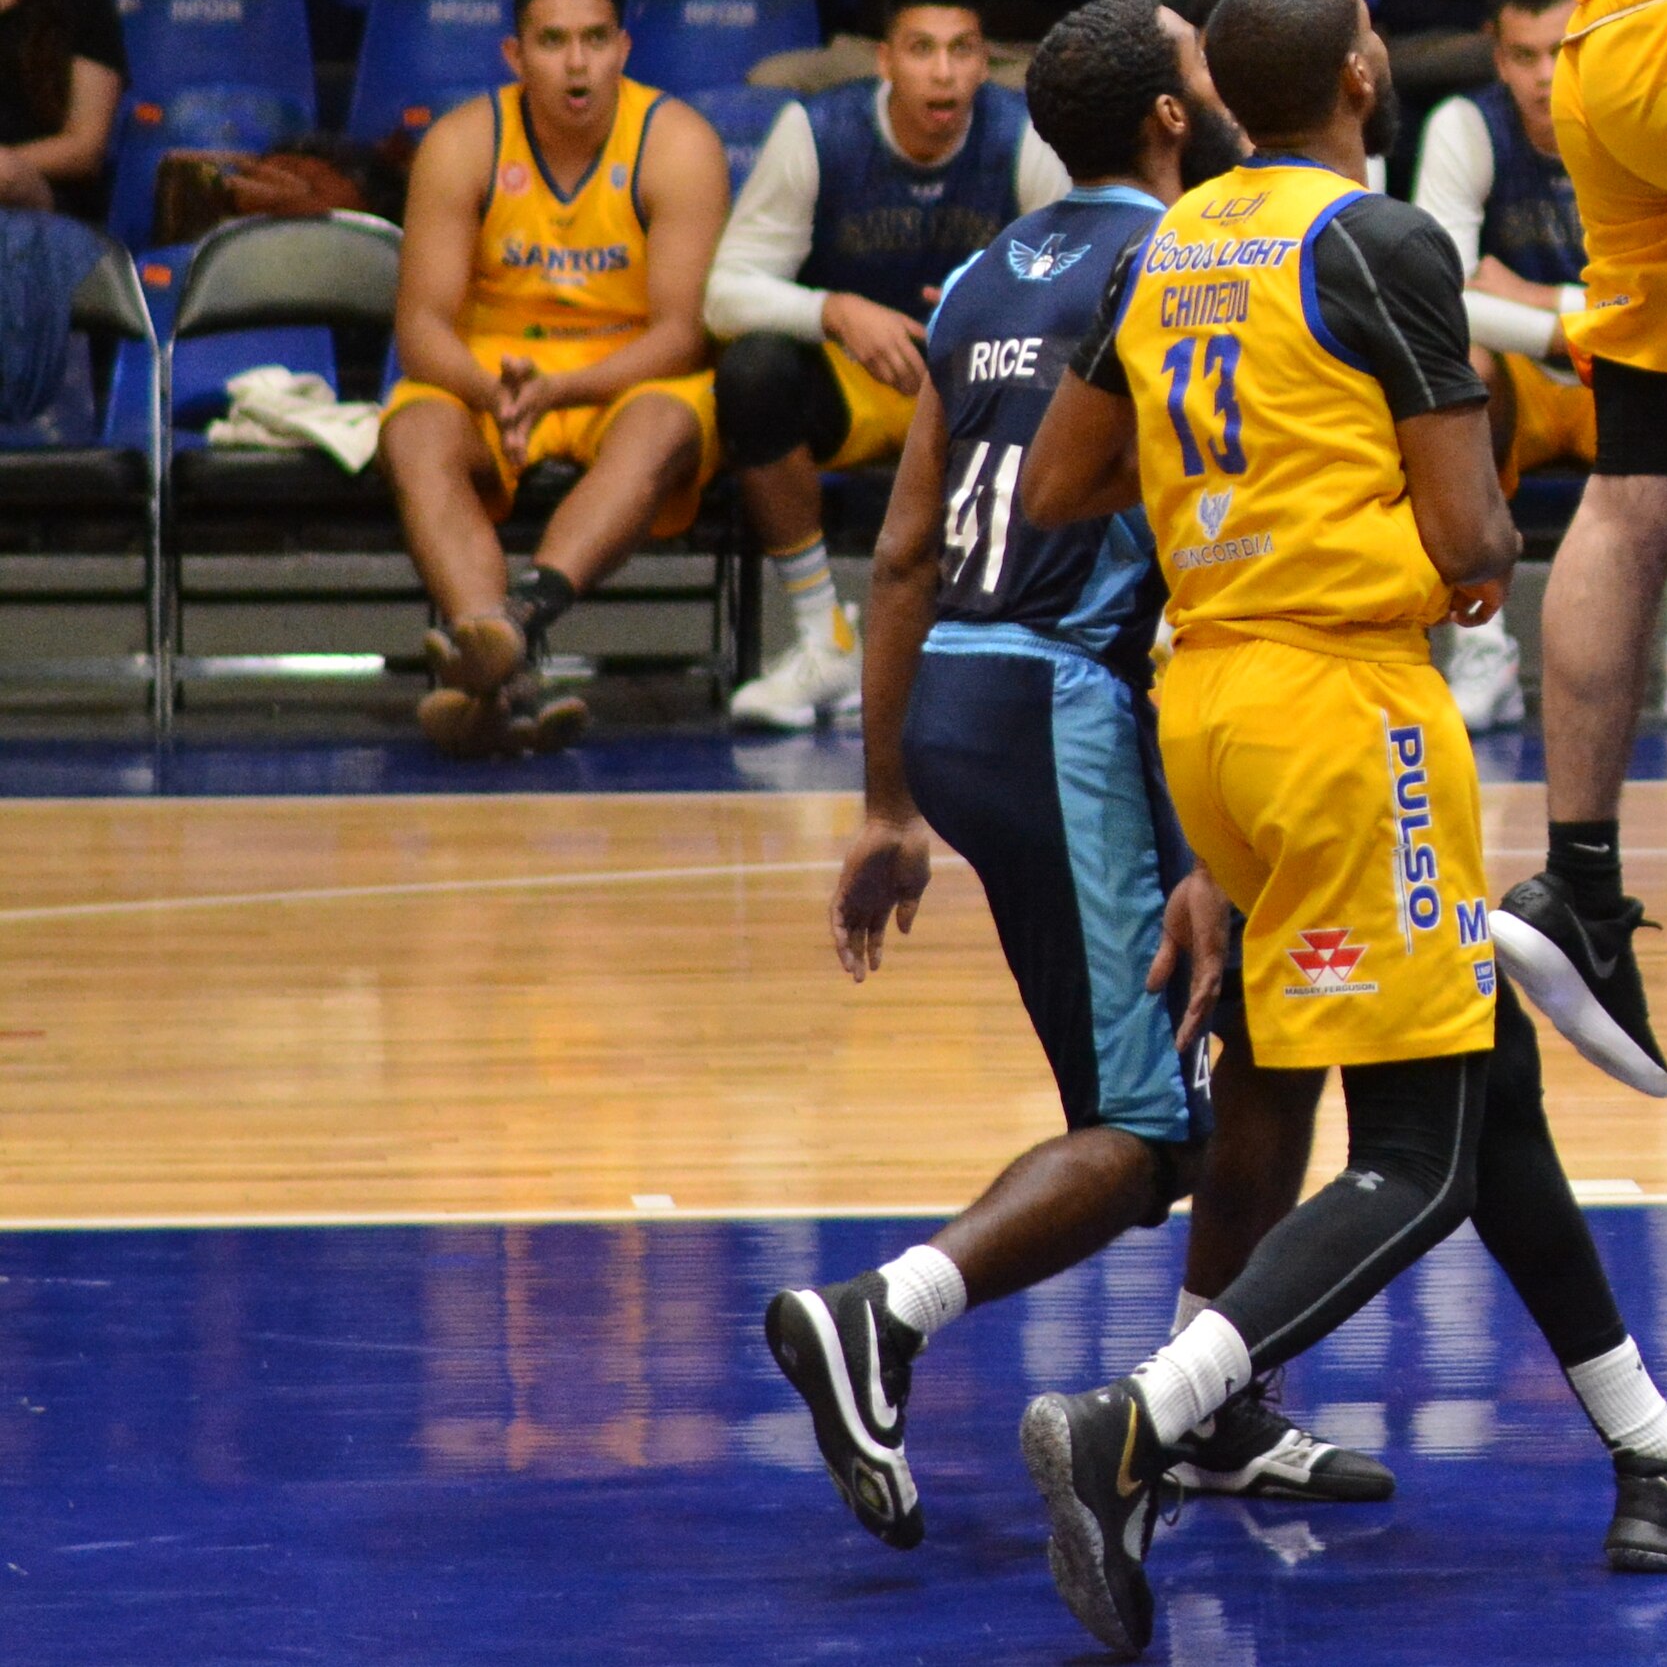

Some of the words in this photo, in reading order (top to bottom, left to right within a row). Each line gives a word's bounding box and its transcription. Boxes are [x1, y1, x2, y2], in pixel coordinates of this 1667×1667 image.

[501, 237, 631, 272] SANTOS
[1146, 231, 1216, 274] Coors
[1216, 239, 1300, 267] LIGHT
[1161, 279, 1250, 328] CHINEDU
[968, 337, 1044, 384] RICE
[1161, 334, 1248, 477] 13
[945, 440, 1023, 594] 41
[1172, 533, 1274, 570] CONCORDIA
[1389, 726, 1440, 929] PULSO
